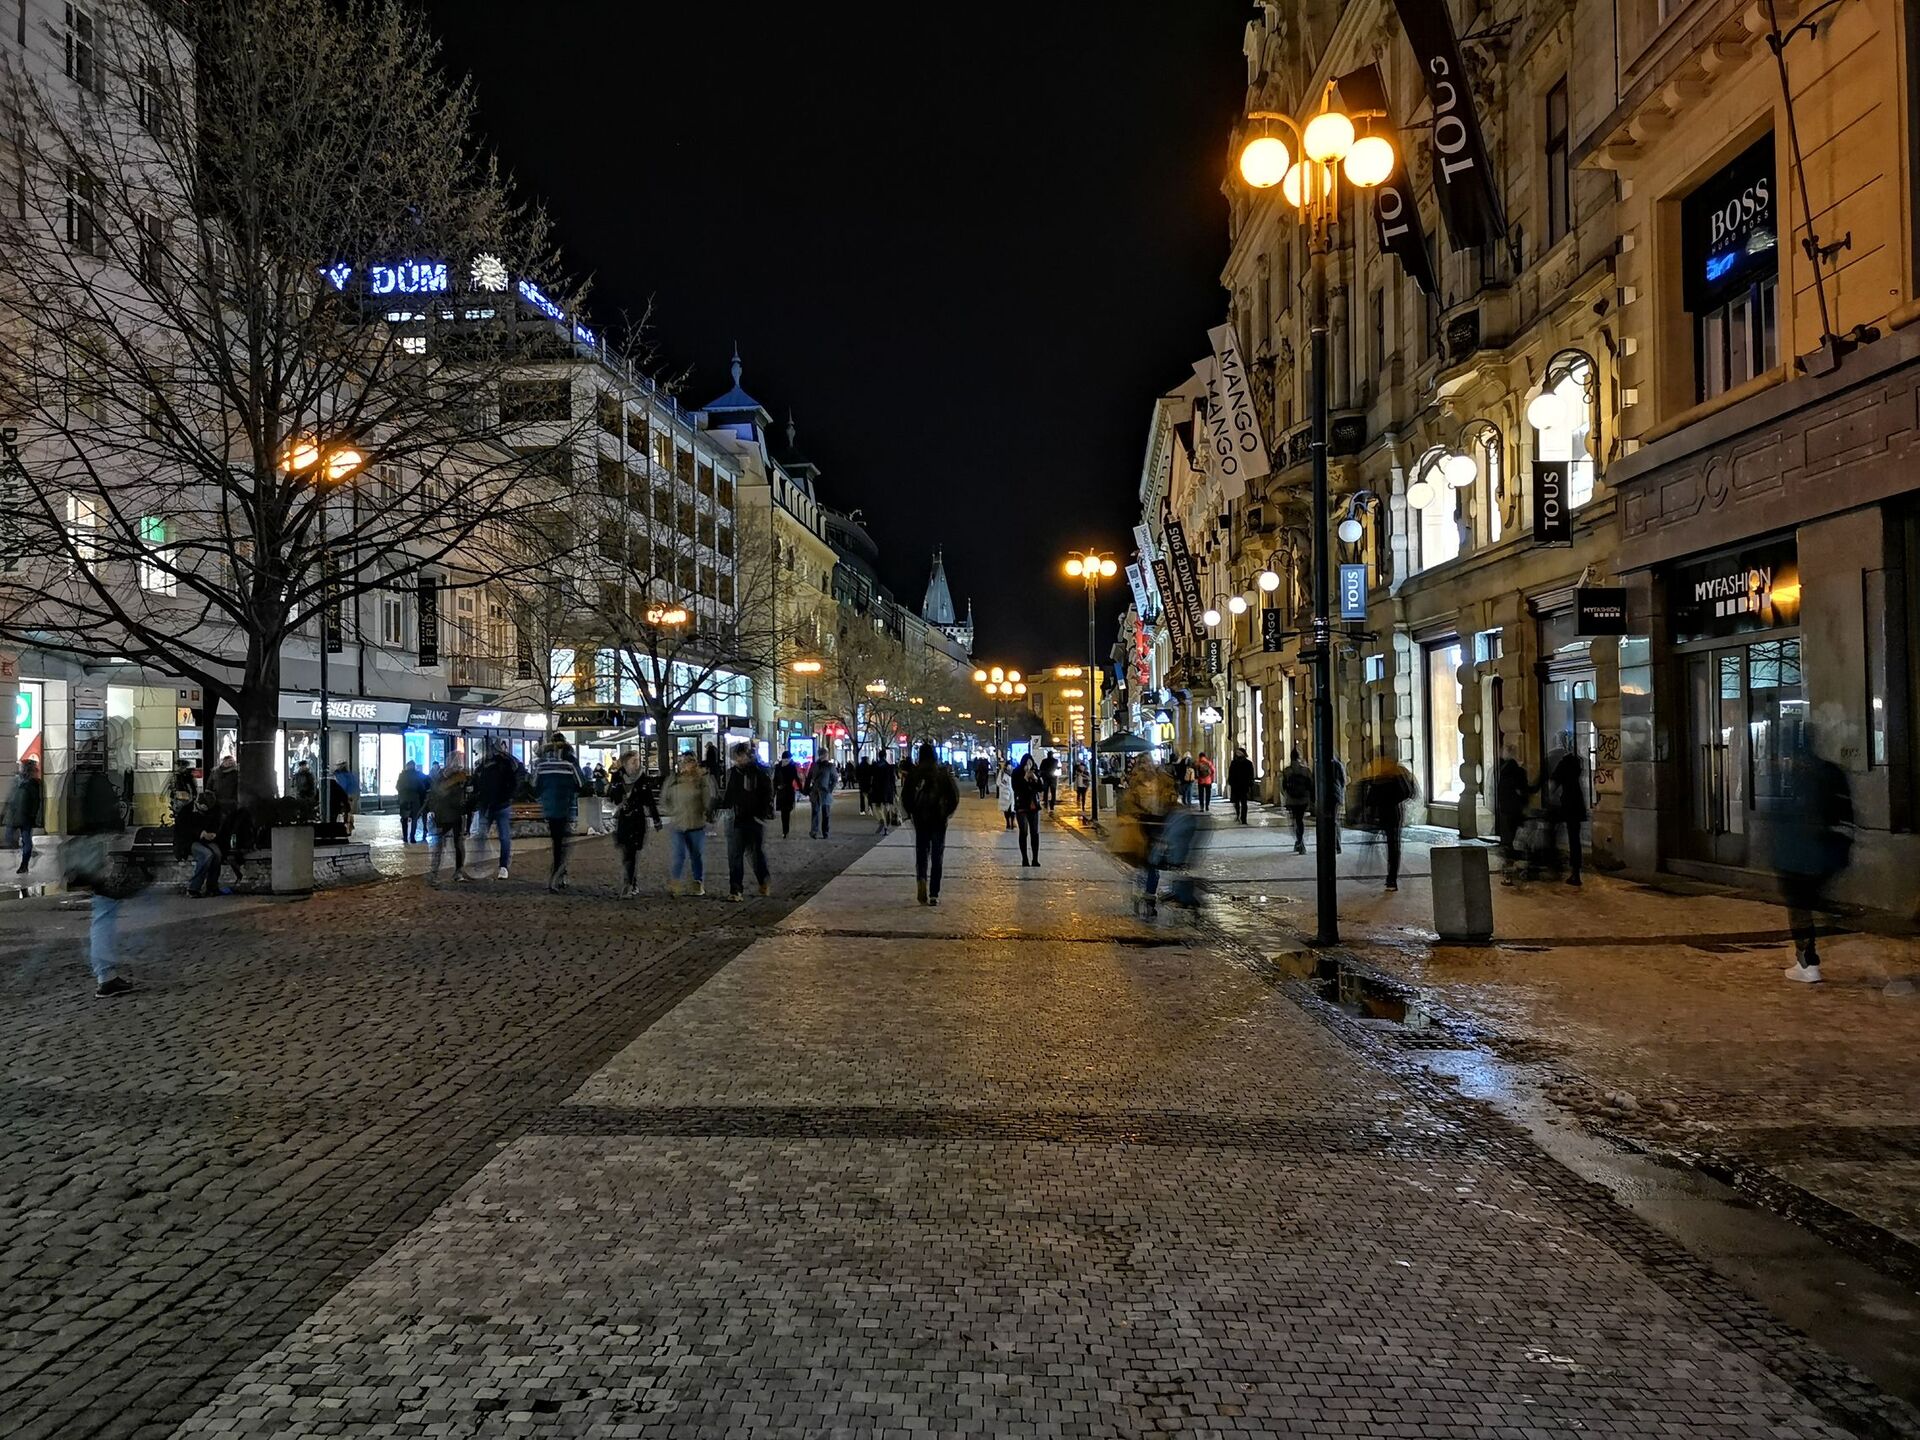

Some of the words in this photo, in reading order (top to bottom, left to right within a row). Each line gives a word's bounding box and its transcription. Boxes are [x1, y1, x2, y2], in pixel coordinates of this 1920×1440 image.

[1430, 56, 1475, 185] TOUS
[1379, 186, 1409, 247] TO
[1710, 178, 1769, 246] BOSS
[1711, 232, 1737, 255] HUGO
[1742, 210, 1769, 234] BOSS
[372, 259, 447, 294] DŮM
[1220, 348, 1258, 453] MANGO
[1206, 379, 1238, 475] MANGO
[1543, 471, 1560, 531] TOUS
[1168, 527, 1186, 556] 1905
[1155, 563, 1170, 588] 1905
[1177, 558, 1195, 592] SINCE
[1347, 571, 1360, 611] TOUS
[1695, 567, 1771, 602] MYFASHION
[1163, 589, 1177, 620] SINCE
[1187, 594, 1206, 635] CASINO
[1170, 620, 1182, 655] CASINO
[1267, 612, 1276, 652] MANGO
[1210, 642, 1218, 674] MANGO
[426, 709, 449, 721] HANGE
